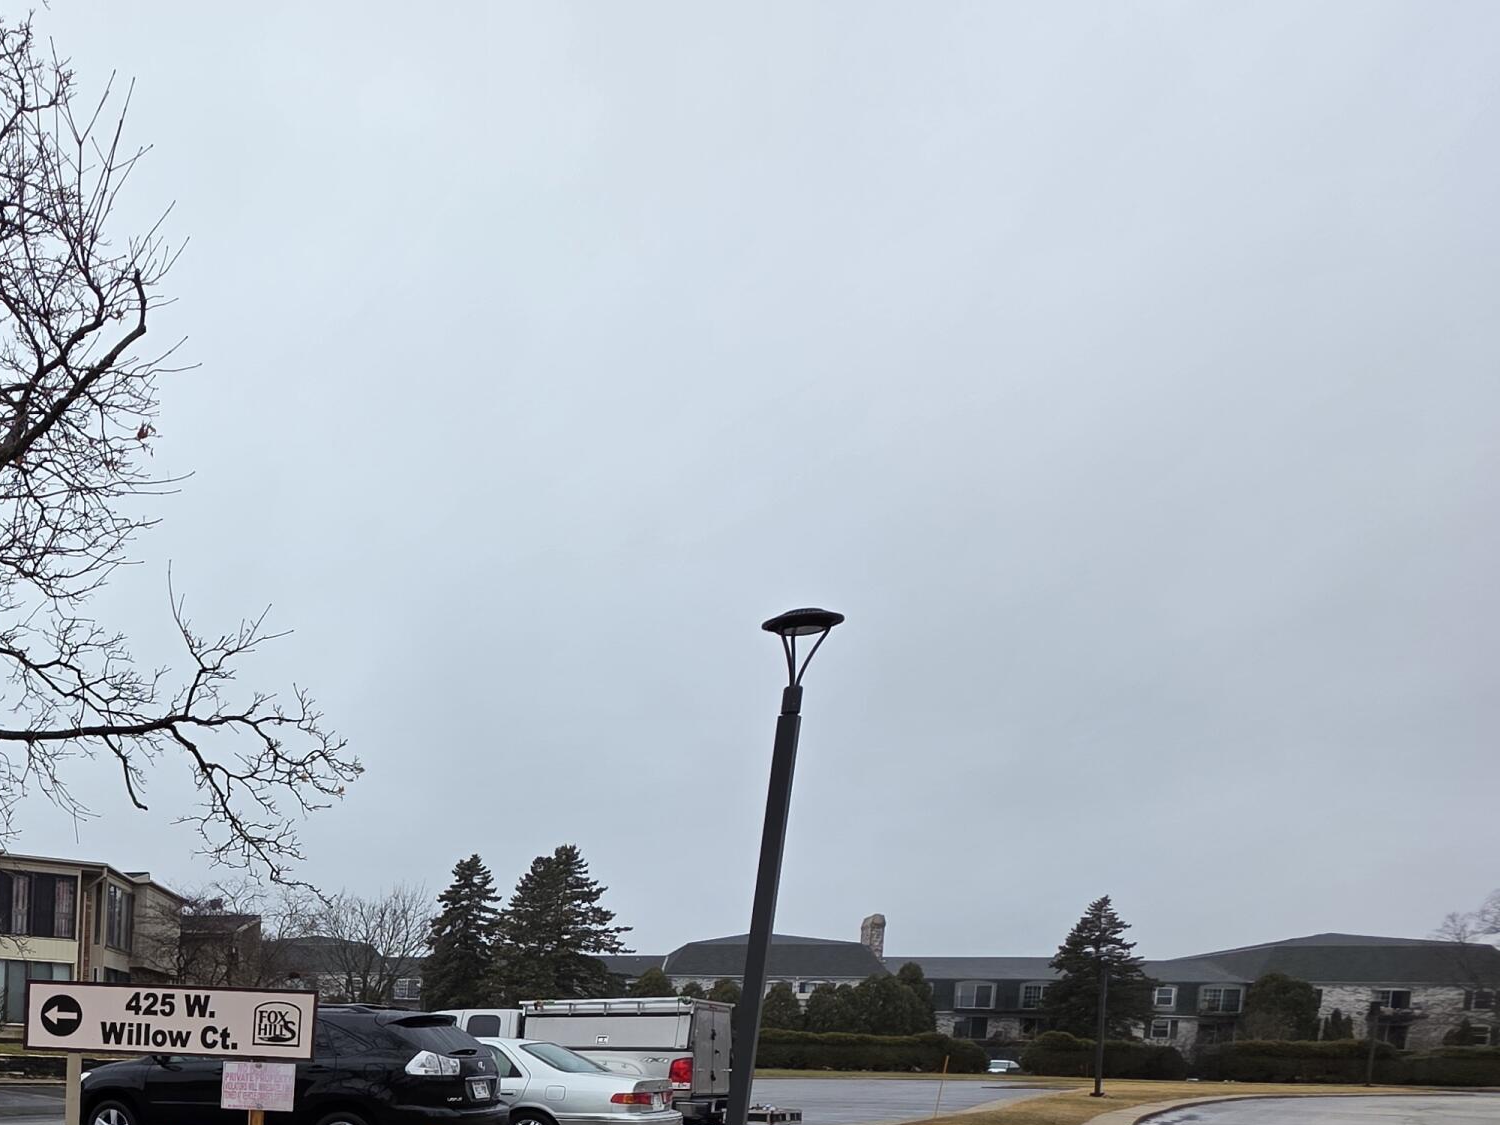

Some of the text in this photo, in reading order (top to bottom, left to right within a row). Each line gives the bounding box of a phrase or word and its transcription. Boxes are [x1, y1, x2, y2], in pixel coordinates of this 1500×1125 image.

[125, 992, 216, 1018] 425 W.
[258, 1010, 289, 1025] FOX
[100, 1021, 238, 1050] Willow Ct.
[257, 1021, 297, 1043] HILLS
[224, 1072, 255, 1082] PRIVATE
